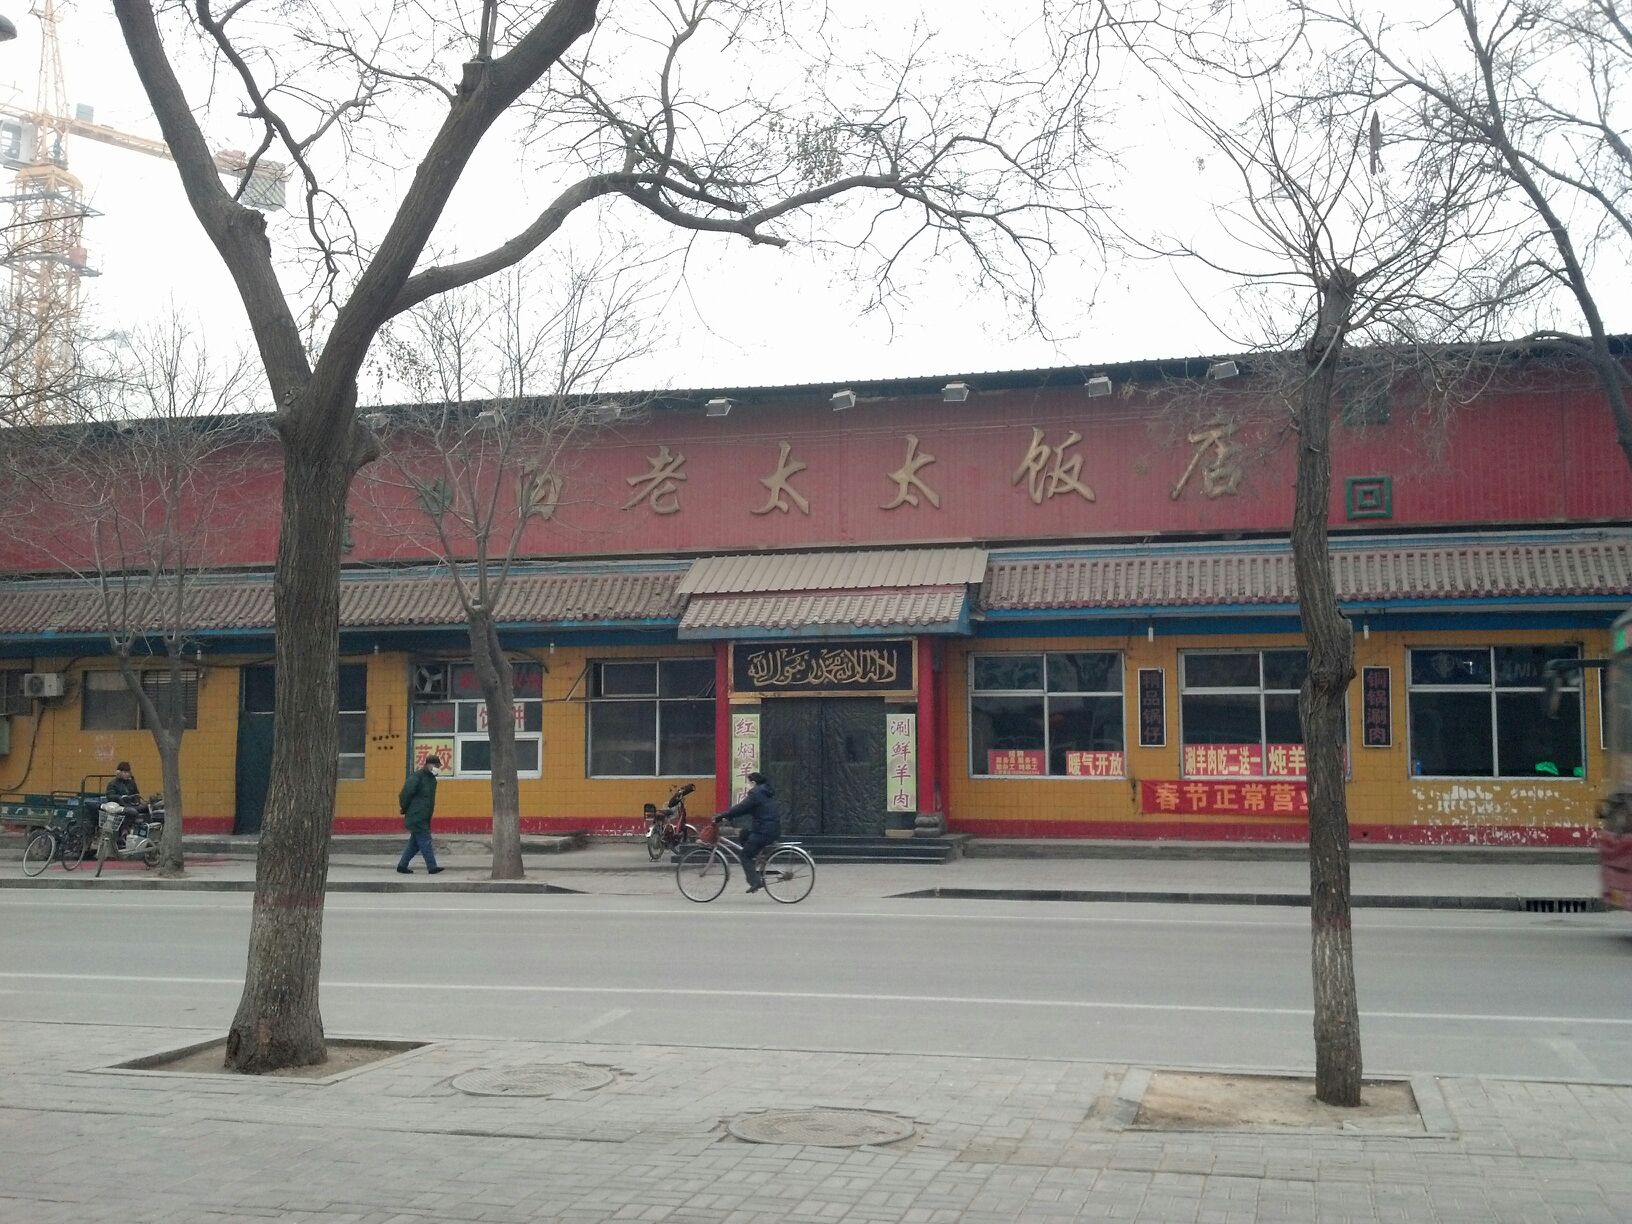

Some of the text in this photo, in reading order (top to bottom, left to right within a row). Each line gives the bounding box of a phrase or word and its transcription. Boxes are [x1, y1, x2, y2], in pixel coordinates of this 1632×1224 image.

[890, 718, 911, 808] 涮鲜羊肉
[1068, 752, 1123, 776] 暖气开放
[1185, 746, 1261, 775] 涮羊肉吃二送一
